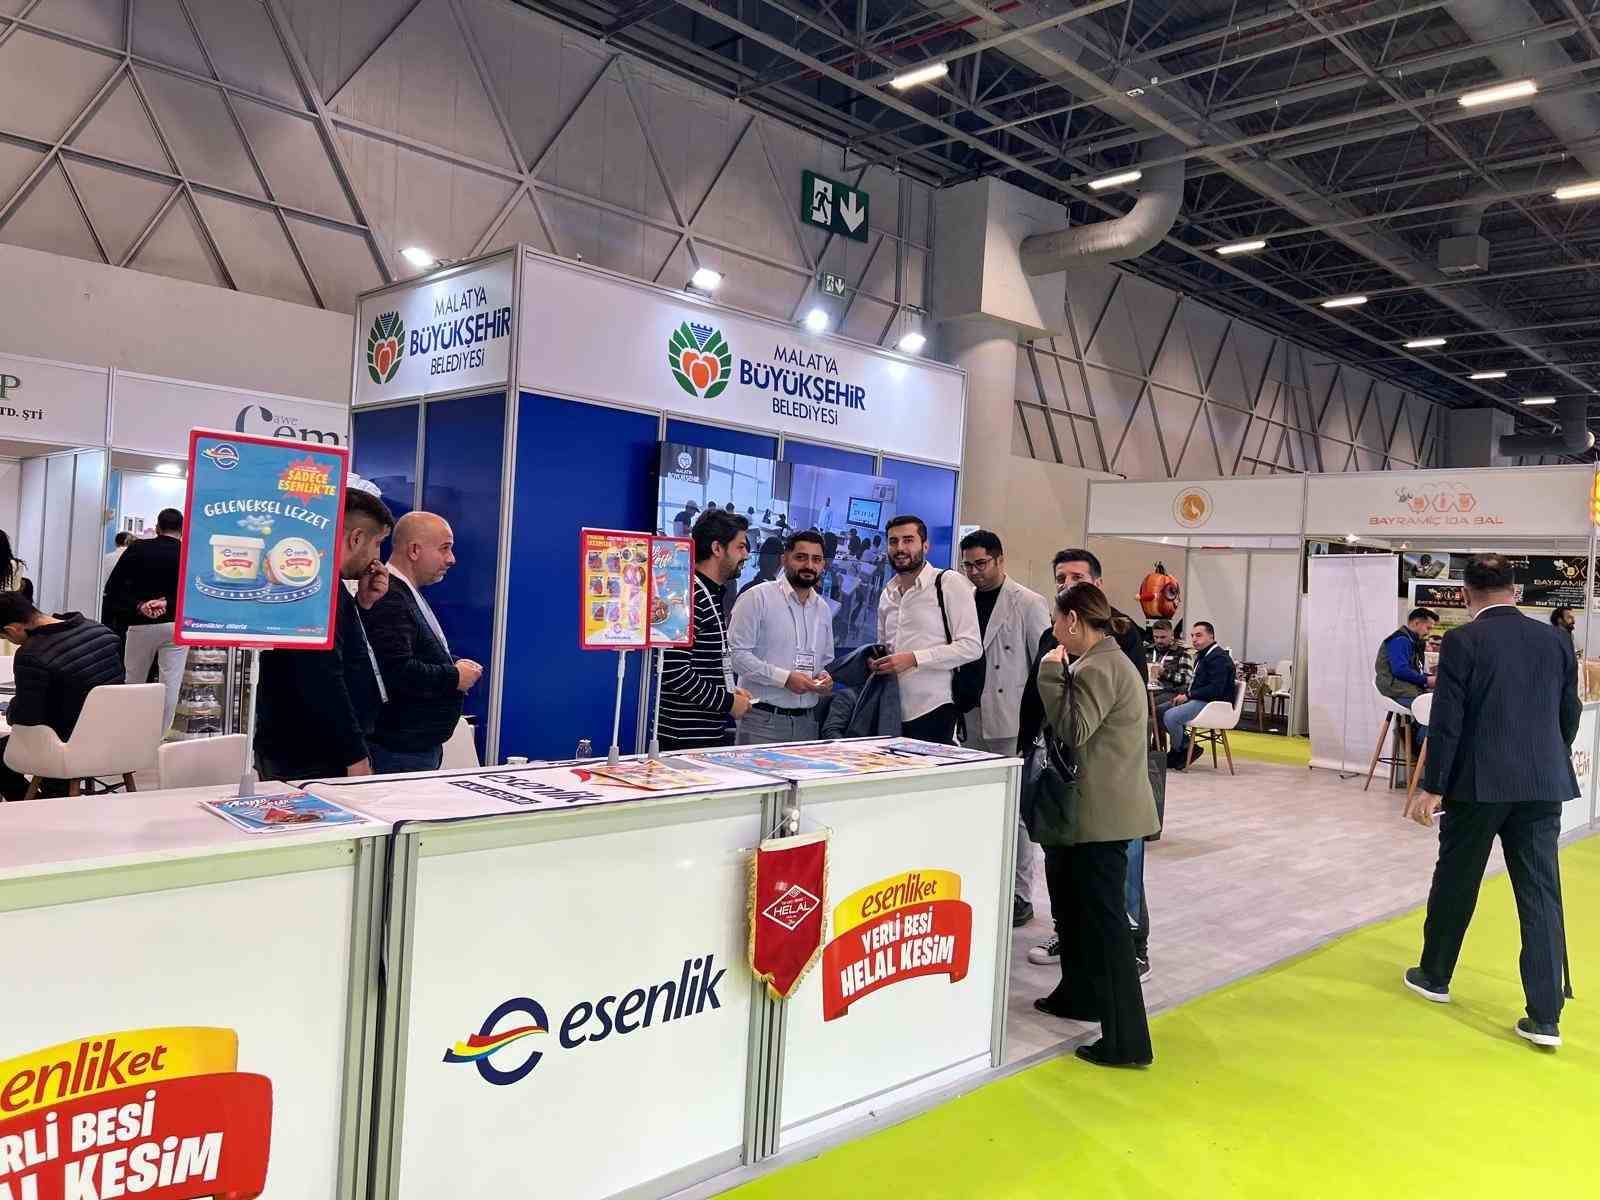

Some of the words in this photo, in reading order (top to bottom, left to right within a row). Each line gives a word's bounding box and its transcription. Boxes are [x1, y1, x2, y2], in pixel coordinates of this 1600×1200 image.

[435, 286, 487, 316] MALATYA
[410, 307, 511, 356] BÜYÜKŞEHİR
[431, 349, 485, 375] BELEDİYESİ
[773, 345, 838, 375] MALATYA
[740, 359, 865, 410] BÜYÜKŞEHİR
[22, 408, 43, 421] ŞTİ
[772, 398, 838, 425] BELEDİYESİ
[288, 469, 329, 485] SADECE
[204, 499, 281, 517] GELENEKSEL
[284, 504, 331, 530] LEZZET
[1472, 515, 1504, 525] BAL
[773, 901, 810, 917] HELAL
[862, 874, 938, 917] esenliket
[861, 912, 901, 953] YERLİ
[904, 906, 933, 936] BESİ
[841, 948, 897, 998] HELAL
[901, 935, 955, 971] KESİM
[559, 954, 728, 1049] esenlik
[71, 1089, 157, 1152] BESİ
[65, 1132, 224, 1200] KESİM
